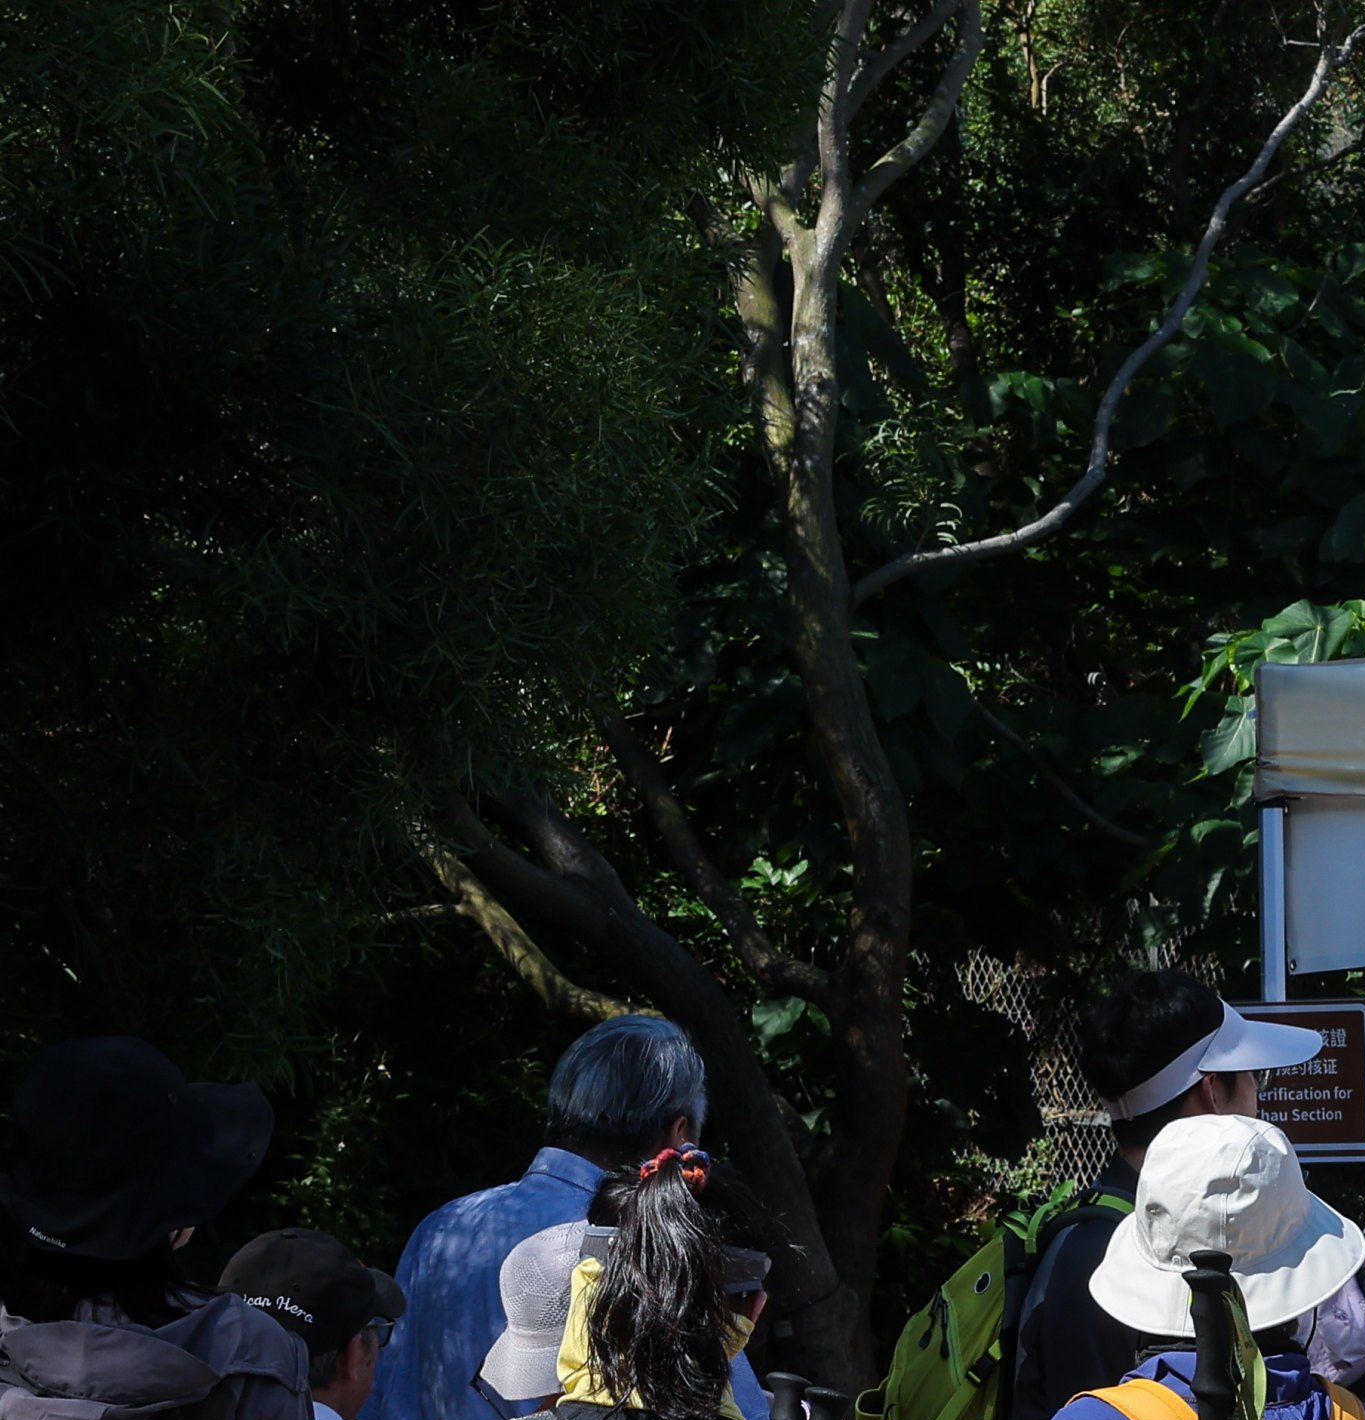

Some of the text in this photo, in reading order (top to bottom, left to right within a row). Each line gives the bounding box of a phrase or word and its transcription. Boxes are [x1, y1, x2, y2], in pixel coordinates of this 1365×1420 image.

[1258, 1085, 1353, 1101] erification for
[1291, 1107, 1343, 1121] Section
